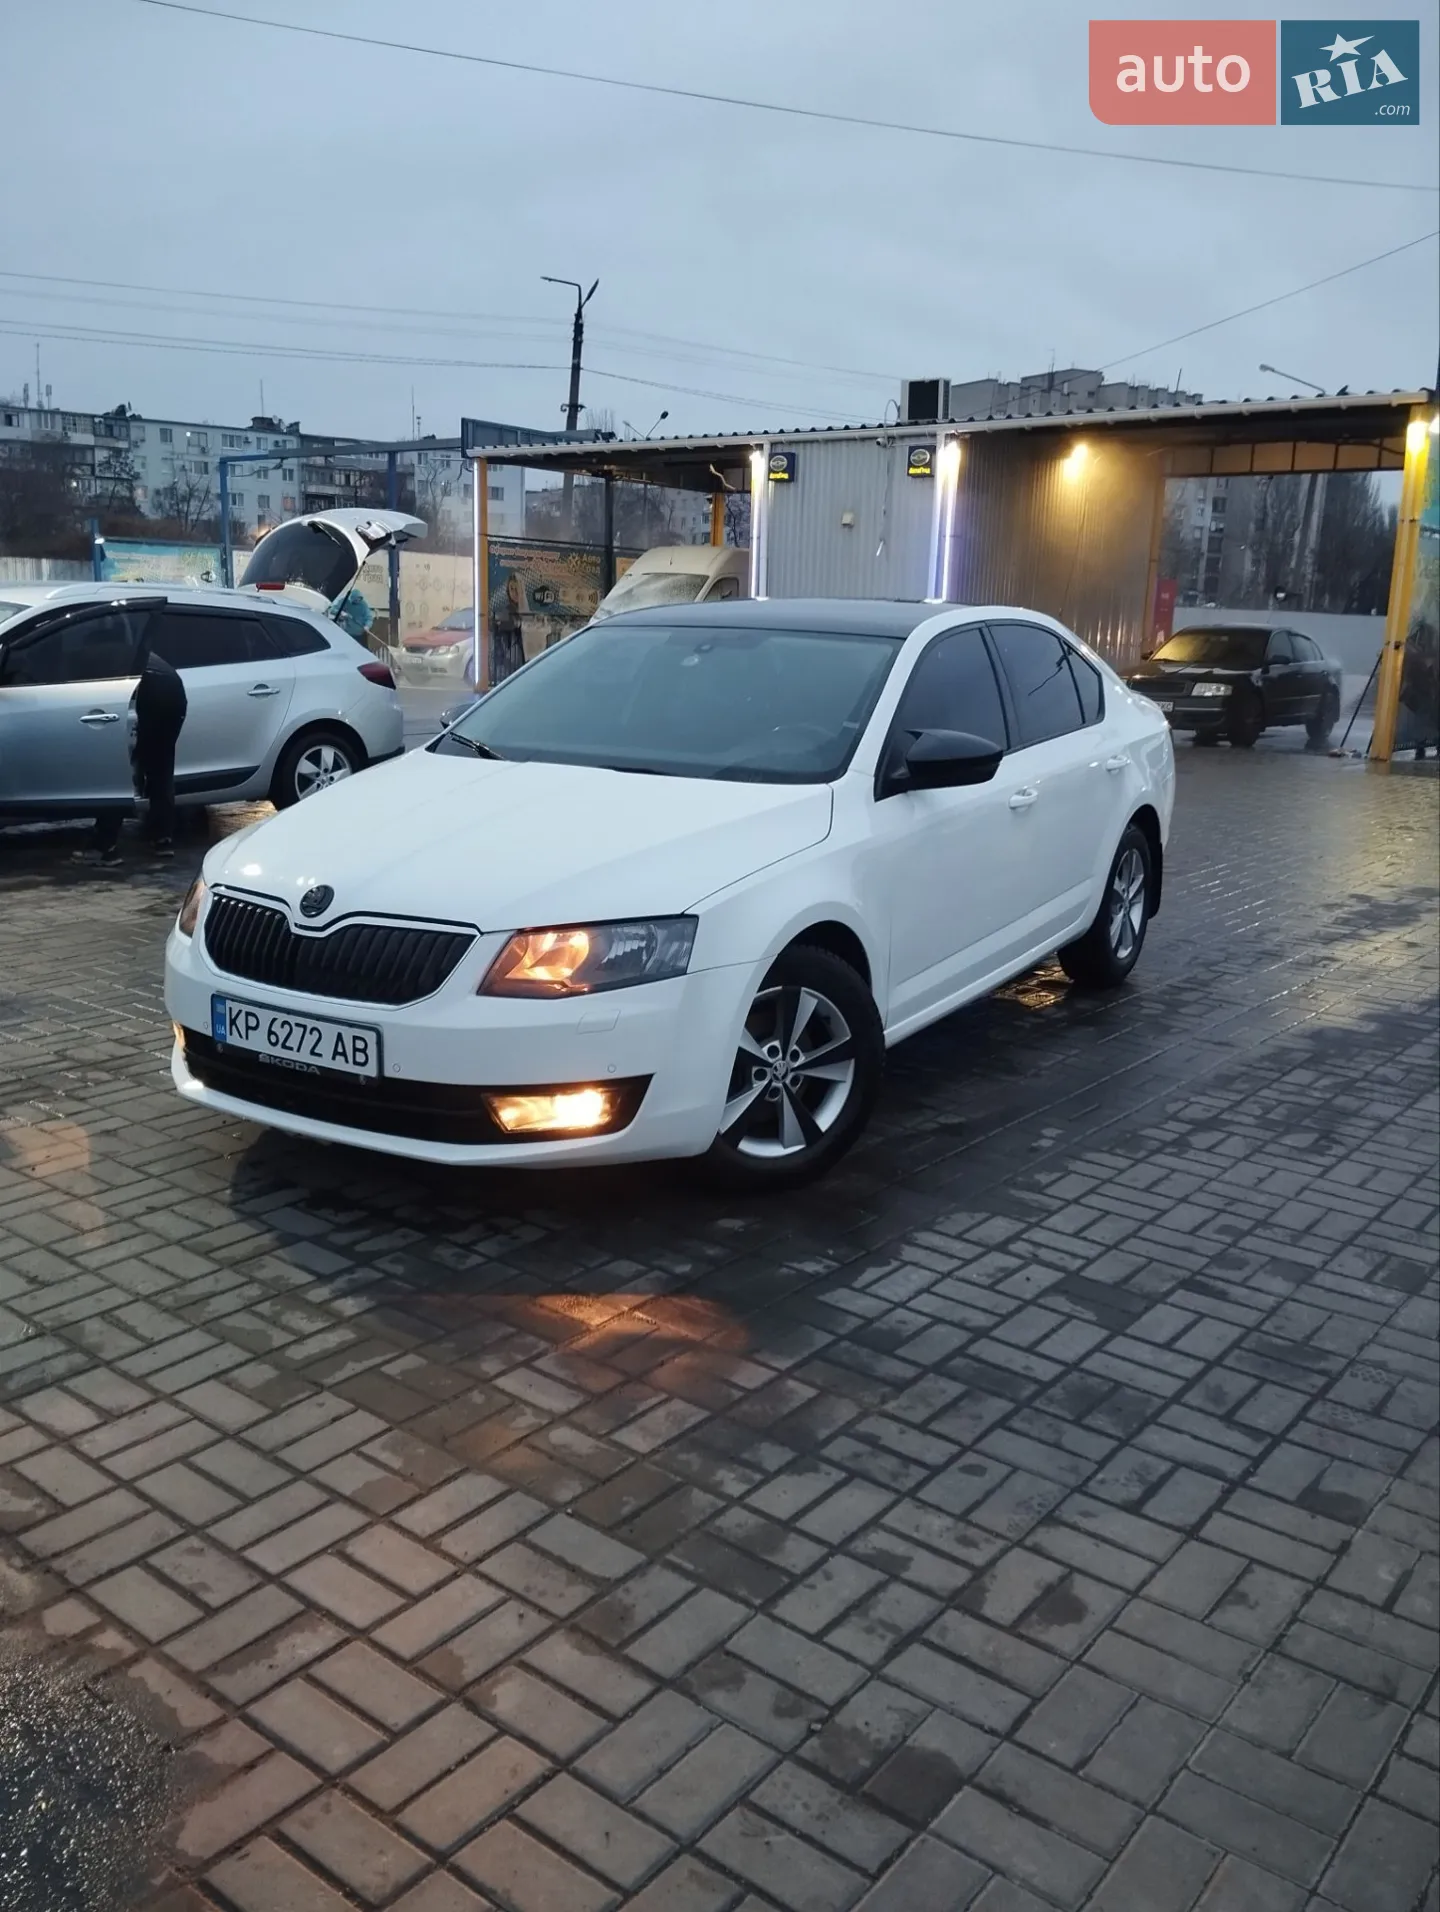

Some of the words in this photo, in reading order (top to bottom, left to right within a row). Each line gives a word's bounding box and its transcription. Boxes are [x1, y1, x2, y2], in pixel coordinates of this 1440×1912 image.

[216, 1023, 226, 1036] UA
[228, 1006, 260, 1041] KP
[266, 1017, 323, 1058] 6272
[331, 1032, 369, 1067] AB
